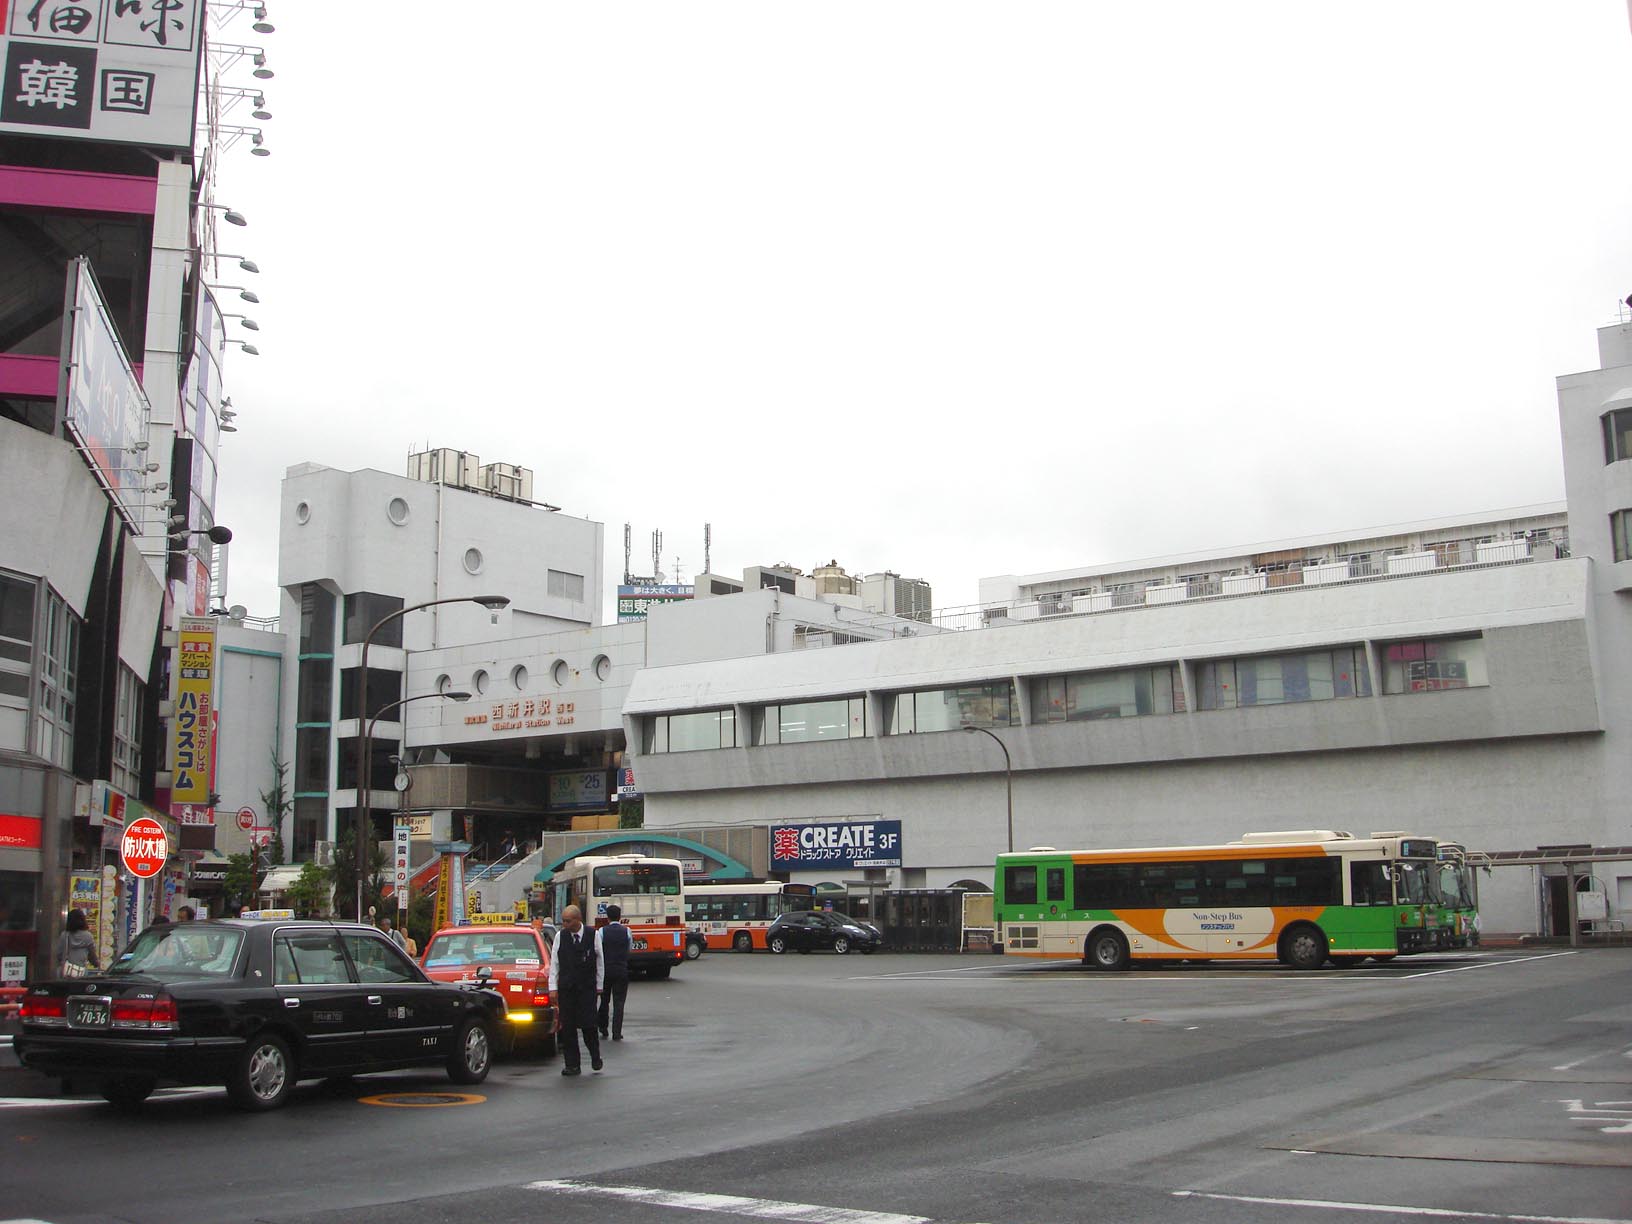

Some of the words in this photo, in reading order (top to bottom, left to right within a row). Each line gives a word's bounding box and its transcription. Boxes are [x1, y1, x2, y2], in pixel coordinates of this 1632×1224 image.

[16, 59, 156, 115] 韓国
[492, 700, 551, 719] 西新井駅
[176, 692, 197, 789] ハウスコム
[197, 692, 209, 773] お部屋さがしは
[584, 774, 600, 789] 25
[143, 827, 162, 835] CISTERN
[801, 825, 875, 849] CREATE
[774, 827, 800, 860] 薬
[880, 833, 897, 849] 3F
[801, 849, 841, 860] ドラッグストア
[846, 848, 875, 859] クリエイト
[1193, 912, 1227, 922] Non-Step
[1229, 912, 1243, 920] Bus
[82, 1011, 106, 1025] 70-36
[422, 1037, 437, 1046] TAXI
